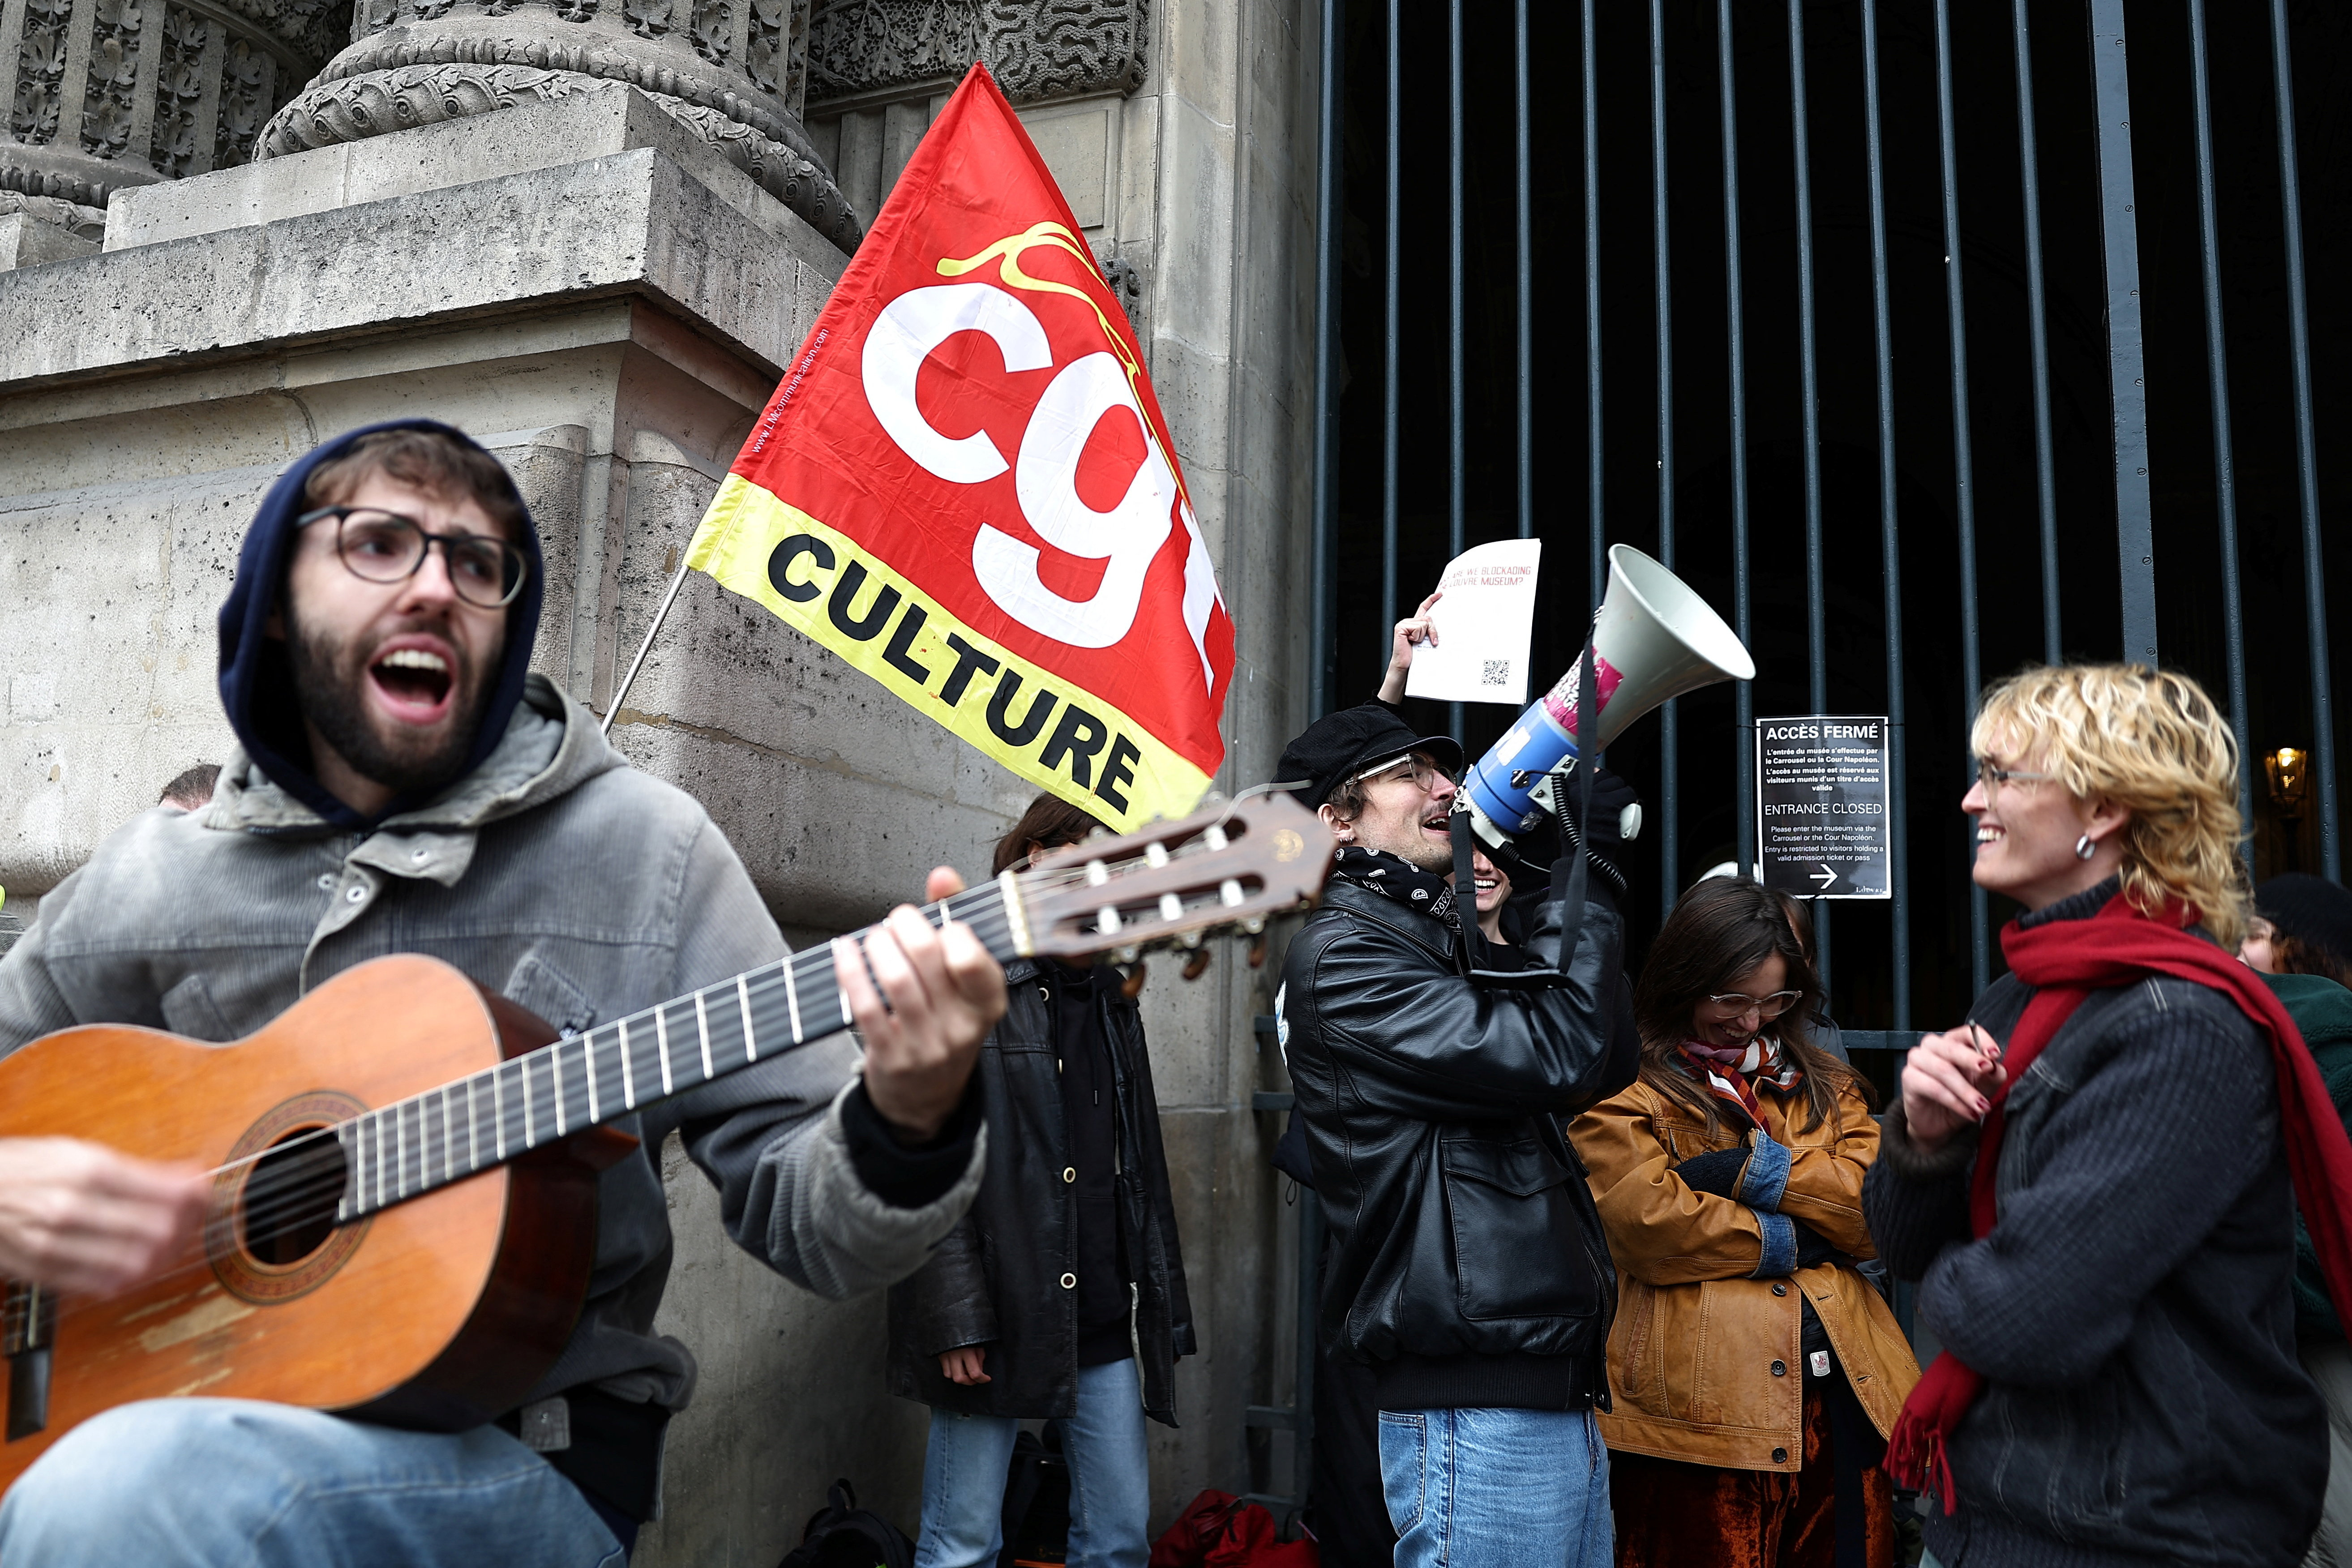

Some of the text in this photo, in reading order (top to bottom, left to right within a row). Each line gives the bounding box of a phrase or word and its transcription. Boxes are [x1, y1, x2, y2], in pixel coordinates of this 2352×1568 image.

[751, 328, 829, 453] www.LMcommunication.com
[1468, 567, 1478, 575] WE
[1481, 566, 1530, 575] BLOCKADING
[1481, 577, 1523, 585] MUSEUM?
[767, 533, 1141, 815] CULTURE
[1766, 723, 1878, 740] ACCÈS FERMÉ
[1765, 803, 1882, 815] ENTRANCE CLOSED
[1842, 834, 1874, 842] Napoléon.
